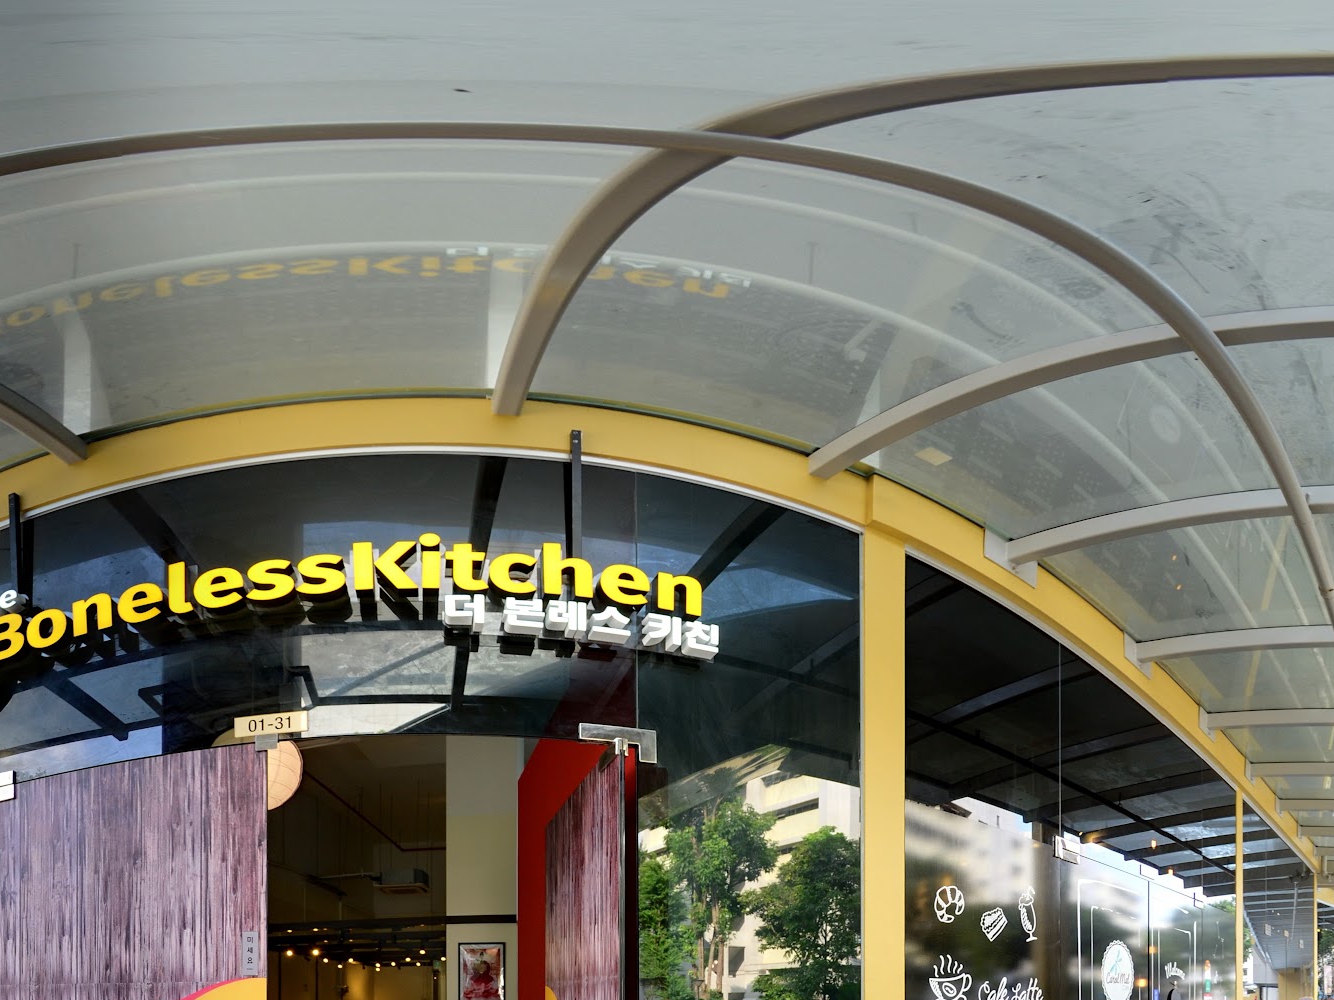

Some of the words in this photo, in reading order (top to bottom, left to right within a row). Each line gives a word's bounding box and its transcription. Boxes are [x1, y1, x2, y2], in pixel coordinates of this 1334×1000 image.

[444, 596, 484, 628] 더
[503, 597, 635, 648] 본레스
[640, 614, 720, 660] 키친
[247, 716, 293, 732] 01-31
